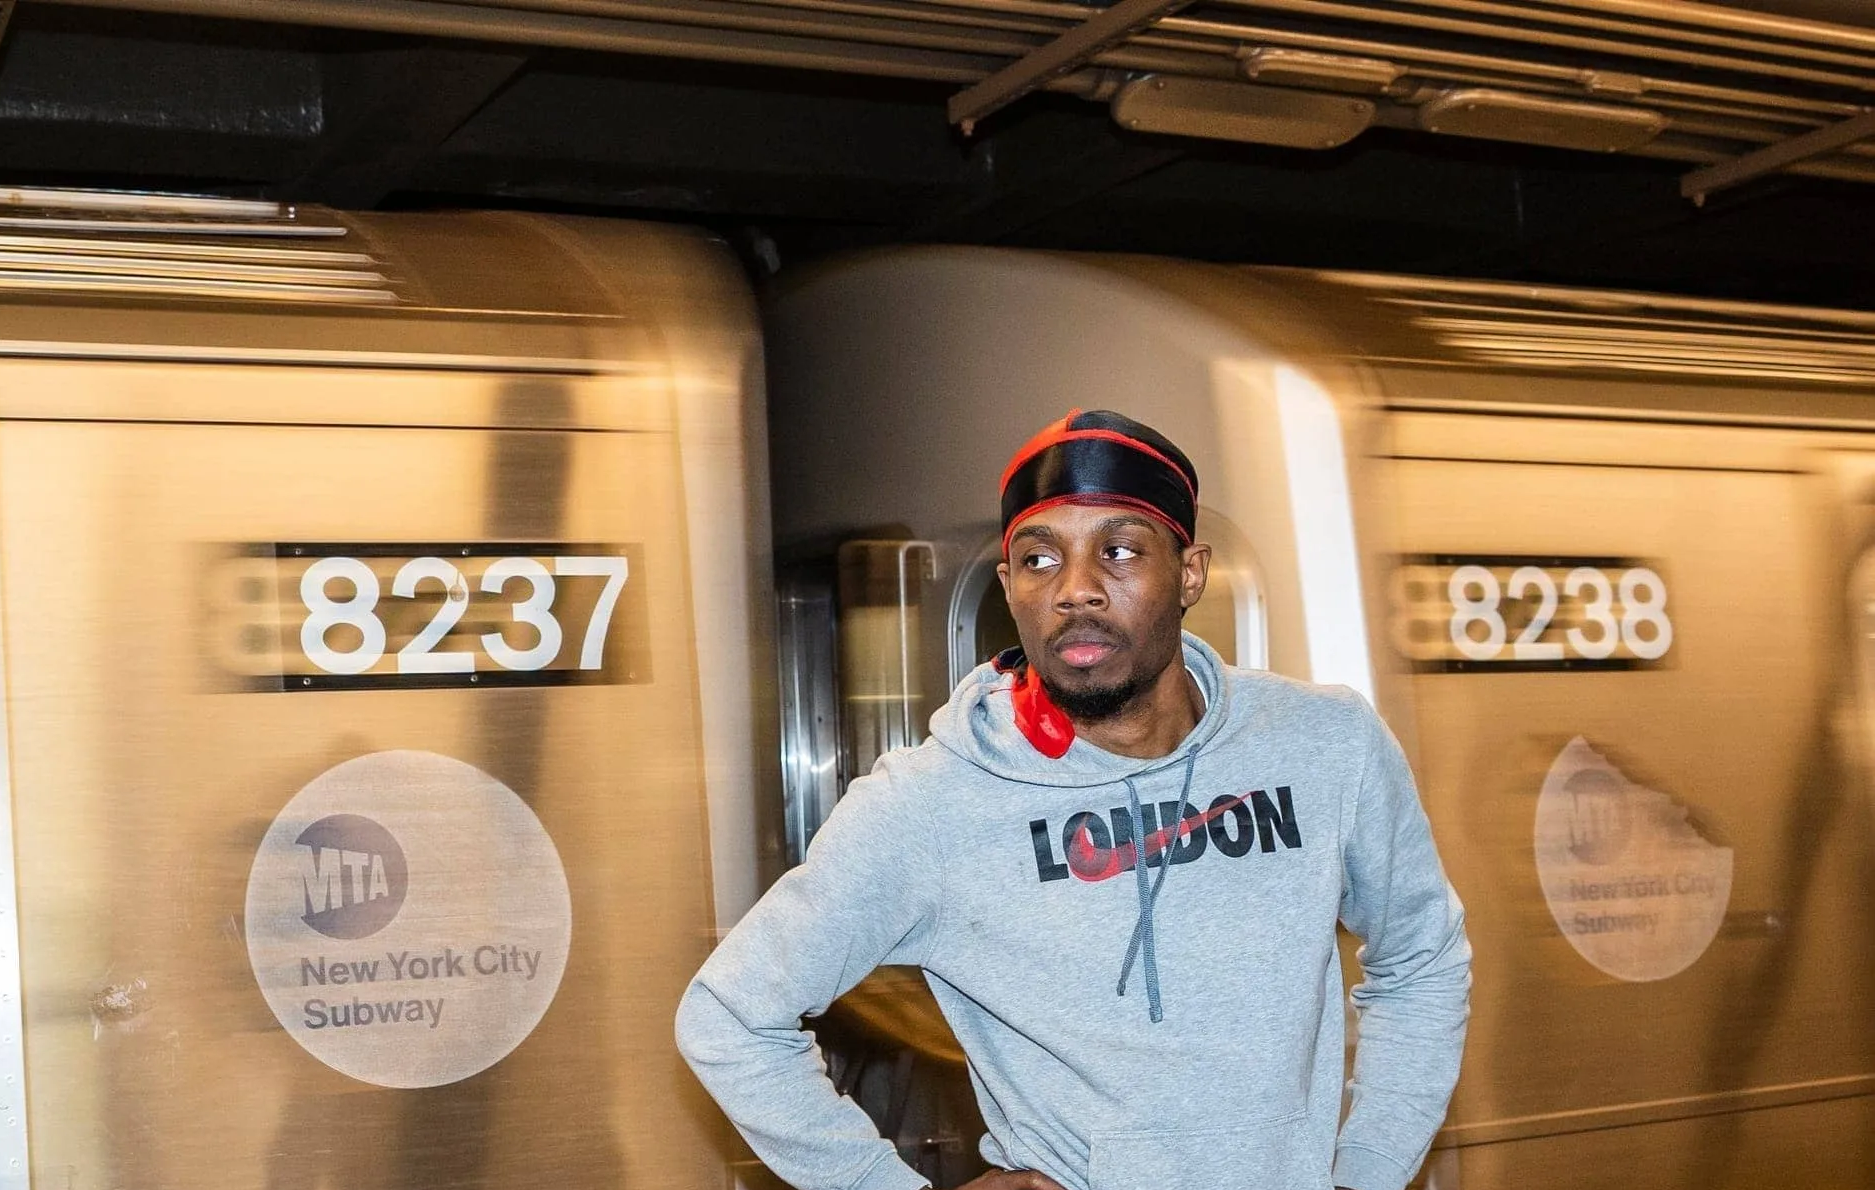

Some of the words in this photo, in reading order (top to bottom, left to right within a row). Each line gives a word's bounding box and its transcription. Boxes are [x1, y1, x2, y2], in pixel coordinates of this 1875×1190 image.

[299, 556, 629, 674] 8237
[1447, 564, 1674, 660] 8238
[1029, 785, 1303, 883] LONDON
[296, 844, 390, 916] MTA
[300, 956, 379, 987] New
[386, 948, 465, 981] York
[472, 942, 543, 978] City
[303, 996, 445, 1030] Subway
